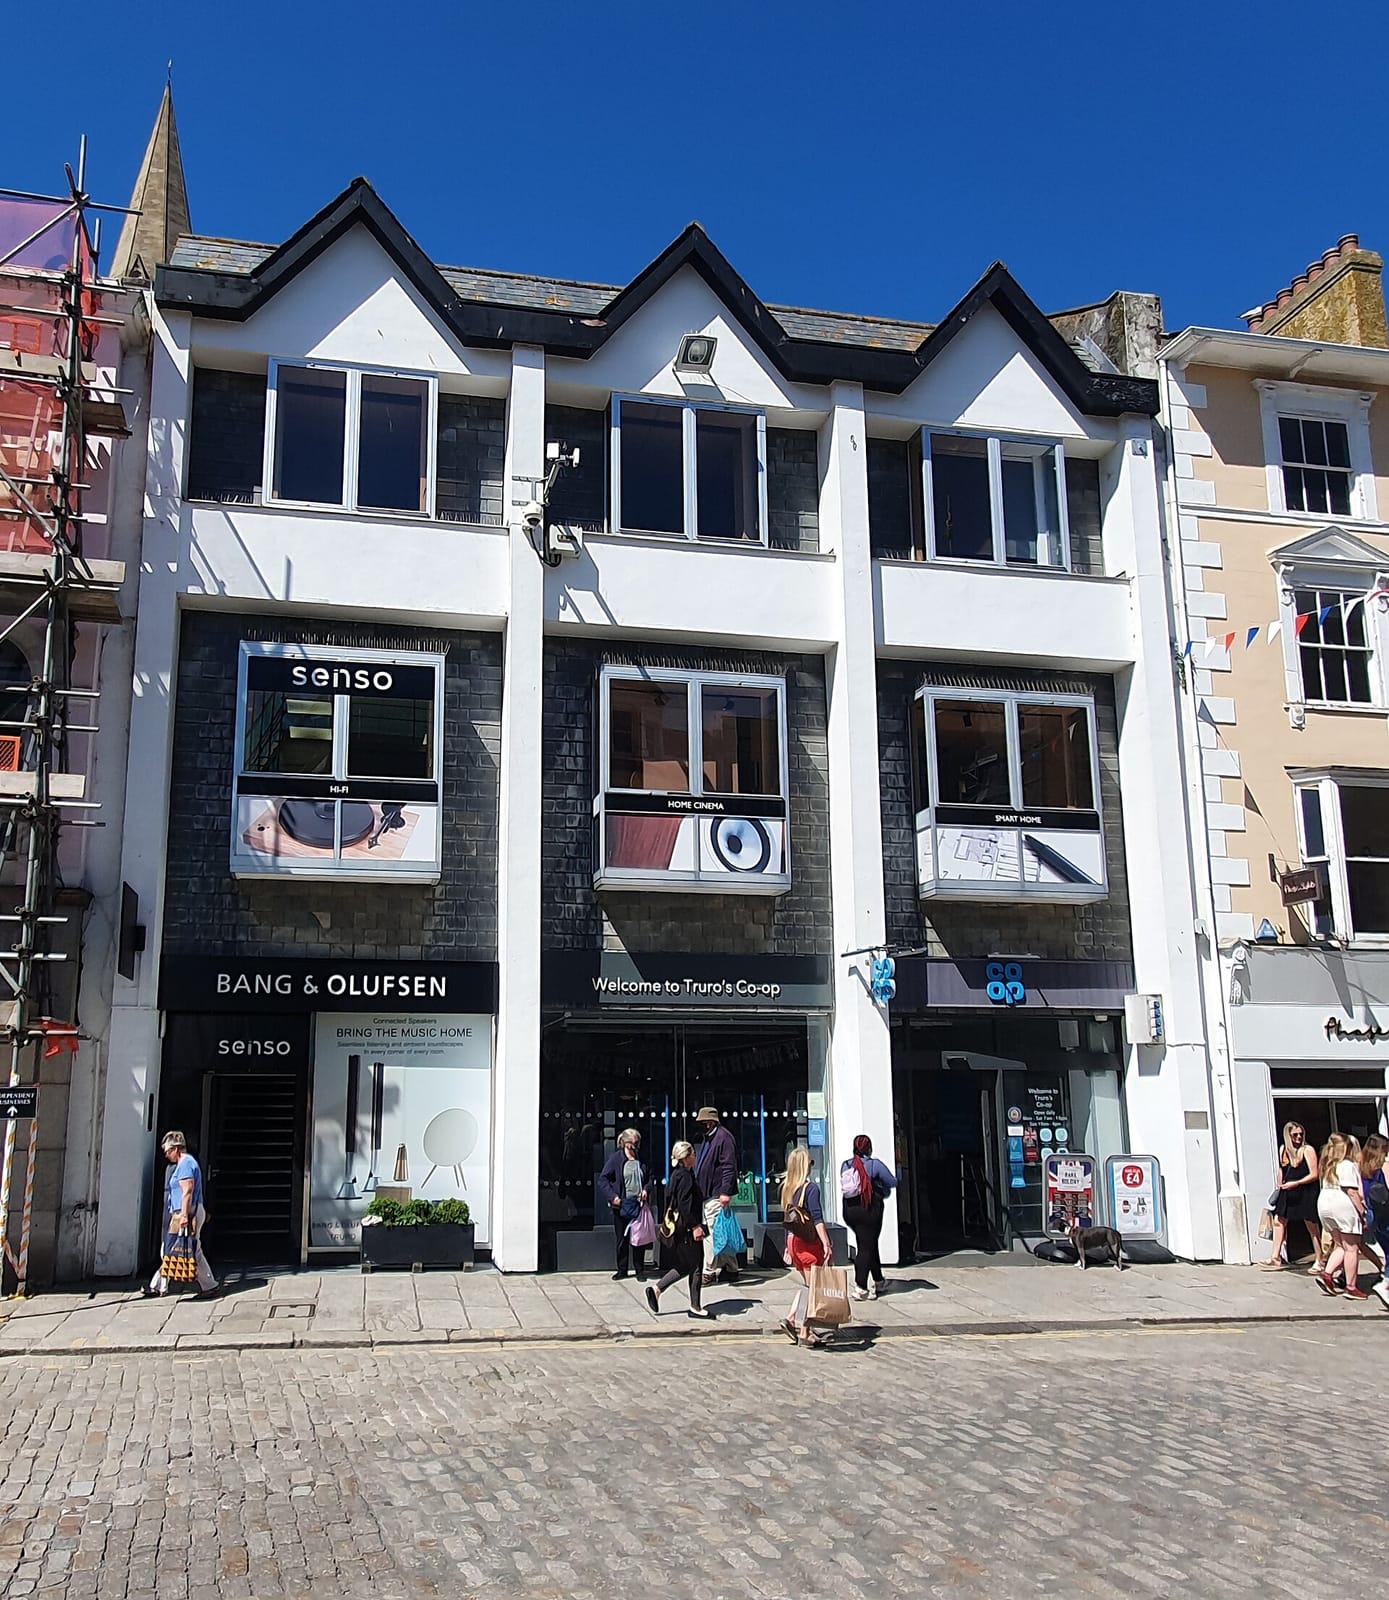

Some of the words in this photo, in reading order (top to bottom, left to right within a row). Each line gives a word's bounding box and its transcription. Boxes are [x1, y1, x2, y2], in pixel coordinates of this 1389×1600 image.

[292, 666, 393, 690] senso
[329, 785, 349, 794] HI-FI
[667, 800, 692, 809] HOME
[693, 801, 725, 810] CINEMA
[995, 814, 1018, 823] SMART
[1019, 815, 1042, 824] HOME
[216, 973, 293, 995] BANG
[303, 974, 320, 995] &
[327, 974, 448, 998] OLUFSEN
[592, 976, 662, 994] Welcome
[663, 979, 681, 994] to
[683, 979, 733, 995] Truro's
[735, 979, 782, 998] Co-op
[372, 1017, 407, 1025] Connected
[408, 1017, 437, 1026] Speakers
[336, 1028, 373, 1038] BRING
[375, 1028, 398, 1038] THE
[401, 1028, 438, 1038] MUSIC
[439, 1028, 473, 1038] HOME
[217, 1039, 291, 1056] senso
[1126, 1173, 1140, 1185] £4
